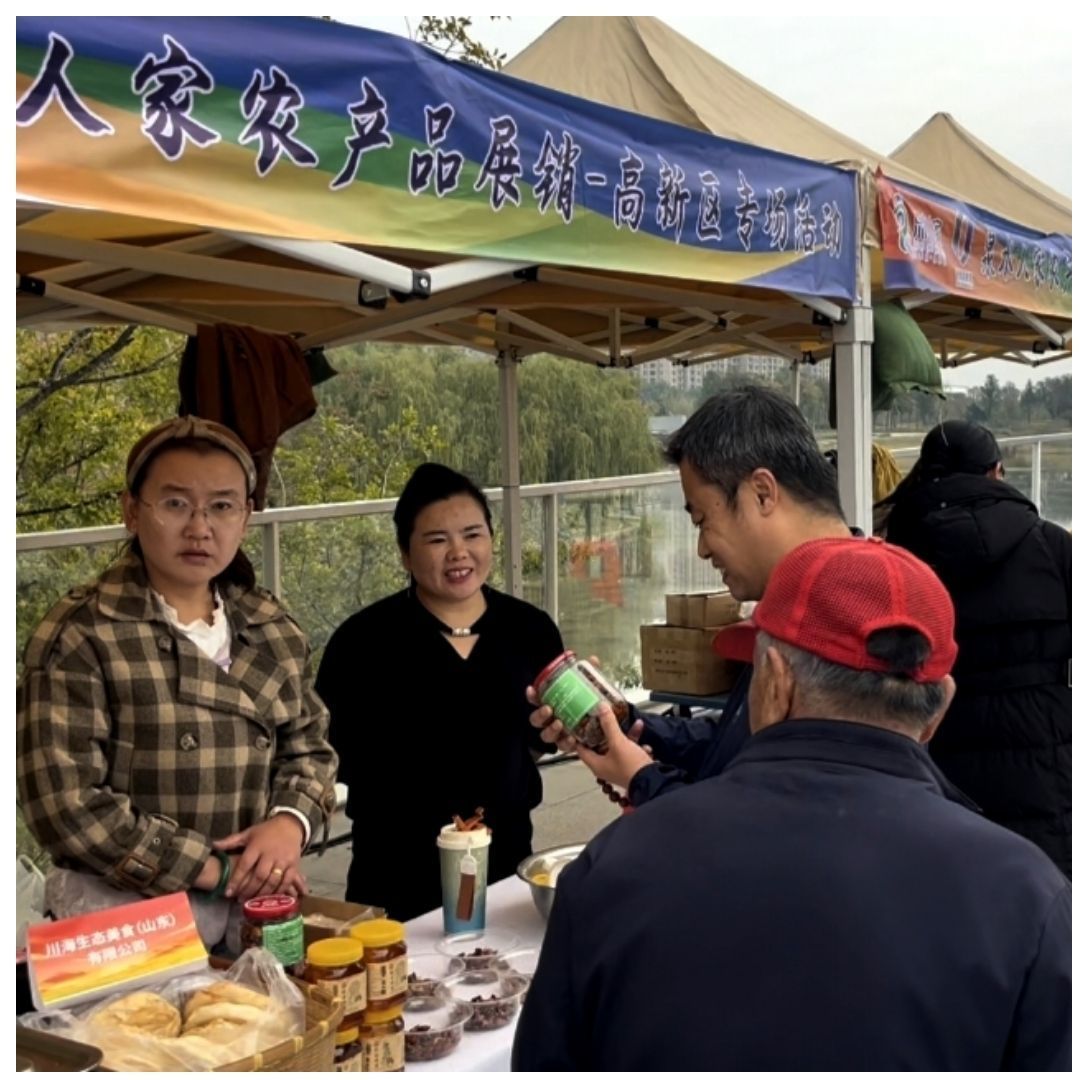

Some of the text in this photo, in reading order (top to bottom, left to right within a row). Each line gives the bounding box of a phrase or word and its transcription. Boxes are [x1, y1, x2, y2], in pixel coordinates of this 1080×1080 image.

[16, 32, 842, 259] 人家农产品展销-高新区专场活动
